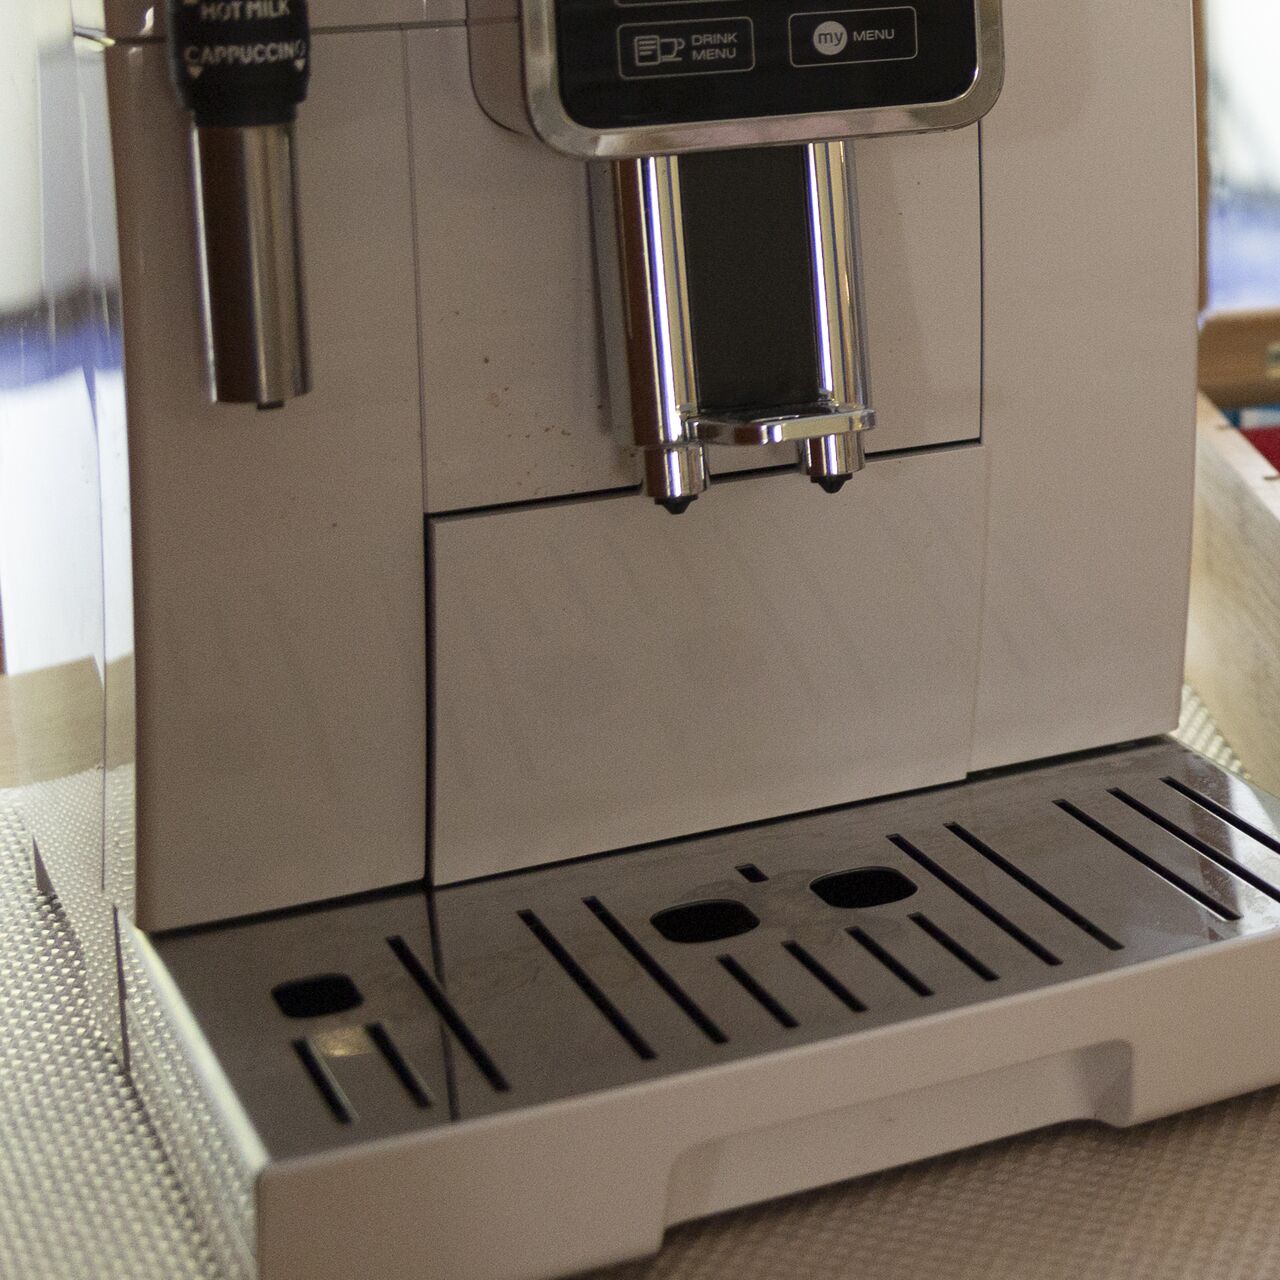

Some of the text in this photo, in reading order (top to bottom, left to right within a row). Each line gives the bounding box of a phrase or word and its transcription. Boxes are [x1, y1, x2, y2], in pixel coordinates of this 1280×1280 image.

[201, 0, 242, 21] HOT
[691, 32, 739, 47] DRINK
[817, 28, 896, 47] my MENU
[184, 39, 307, 64] CAPPUCCINO
[691, 47, 738, 61] MENU
